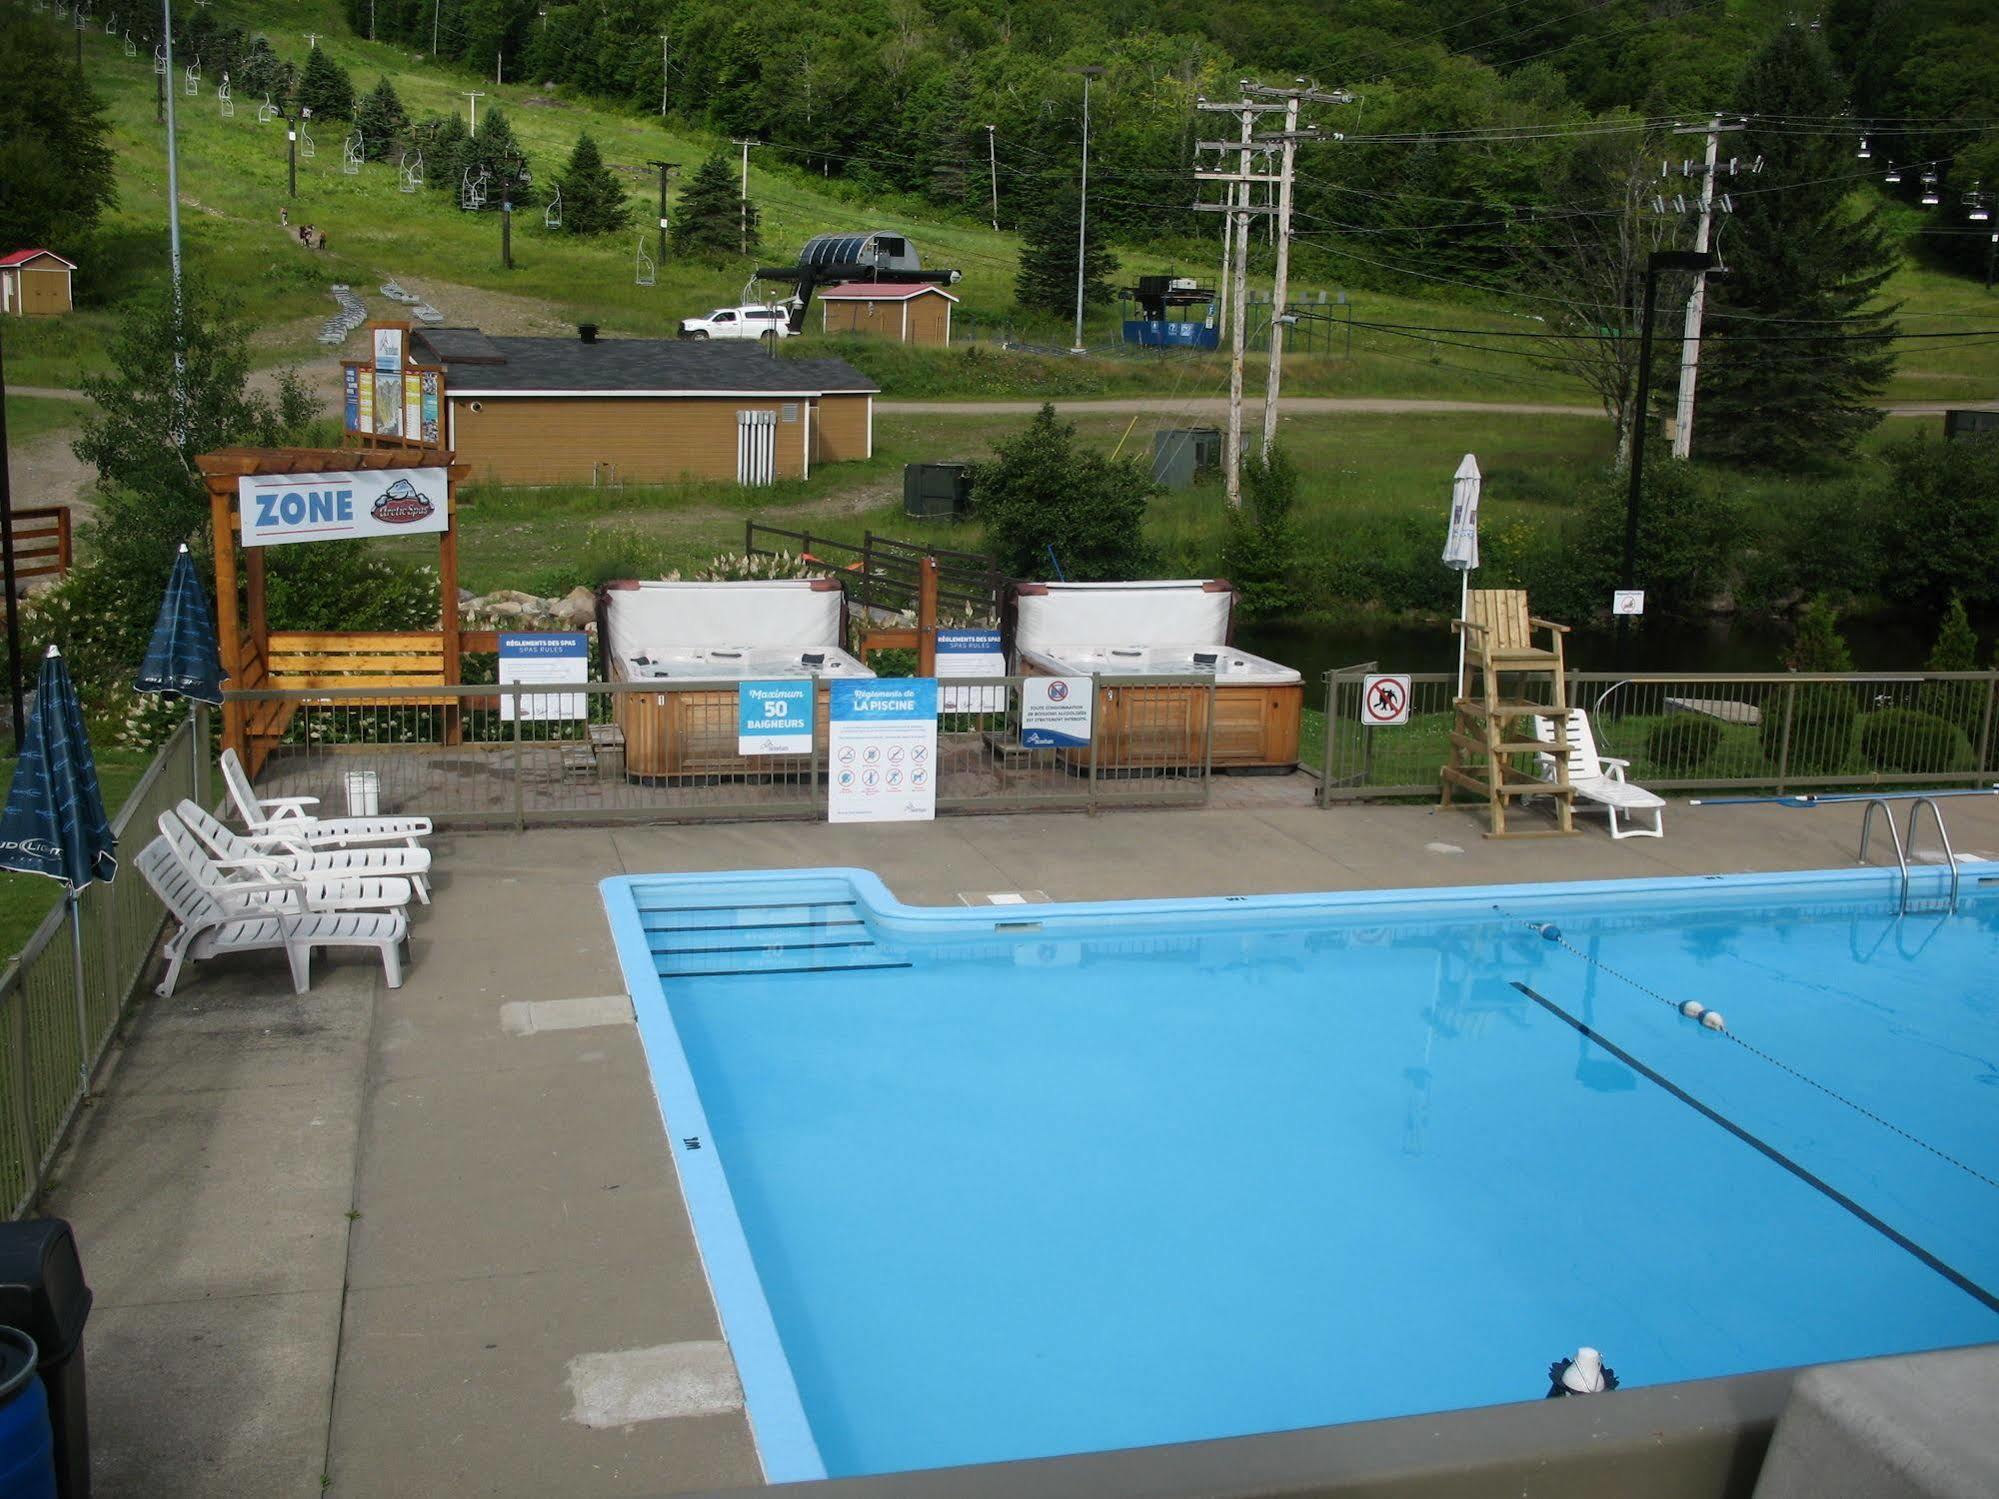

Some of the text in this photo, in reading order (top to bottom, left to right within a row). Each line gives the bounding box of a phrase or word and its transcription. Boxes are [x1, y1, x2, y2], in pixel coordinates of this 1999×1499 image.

[255, 490, 354, 527] ZONE
[749, 688, 805, 700] Maximum
[903, 689, 915, 698] de
[764, 700, 788, 718] 50
[854, 700, 915, 711] LA PISCINE
[746, 719, 805, 730] BAIGNEURS
